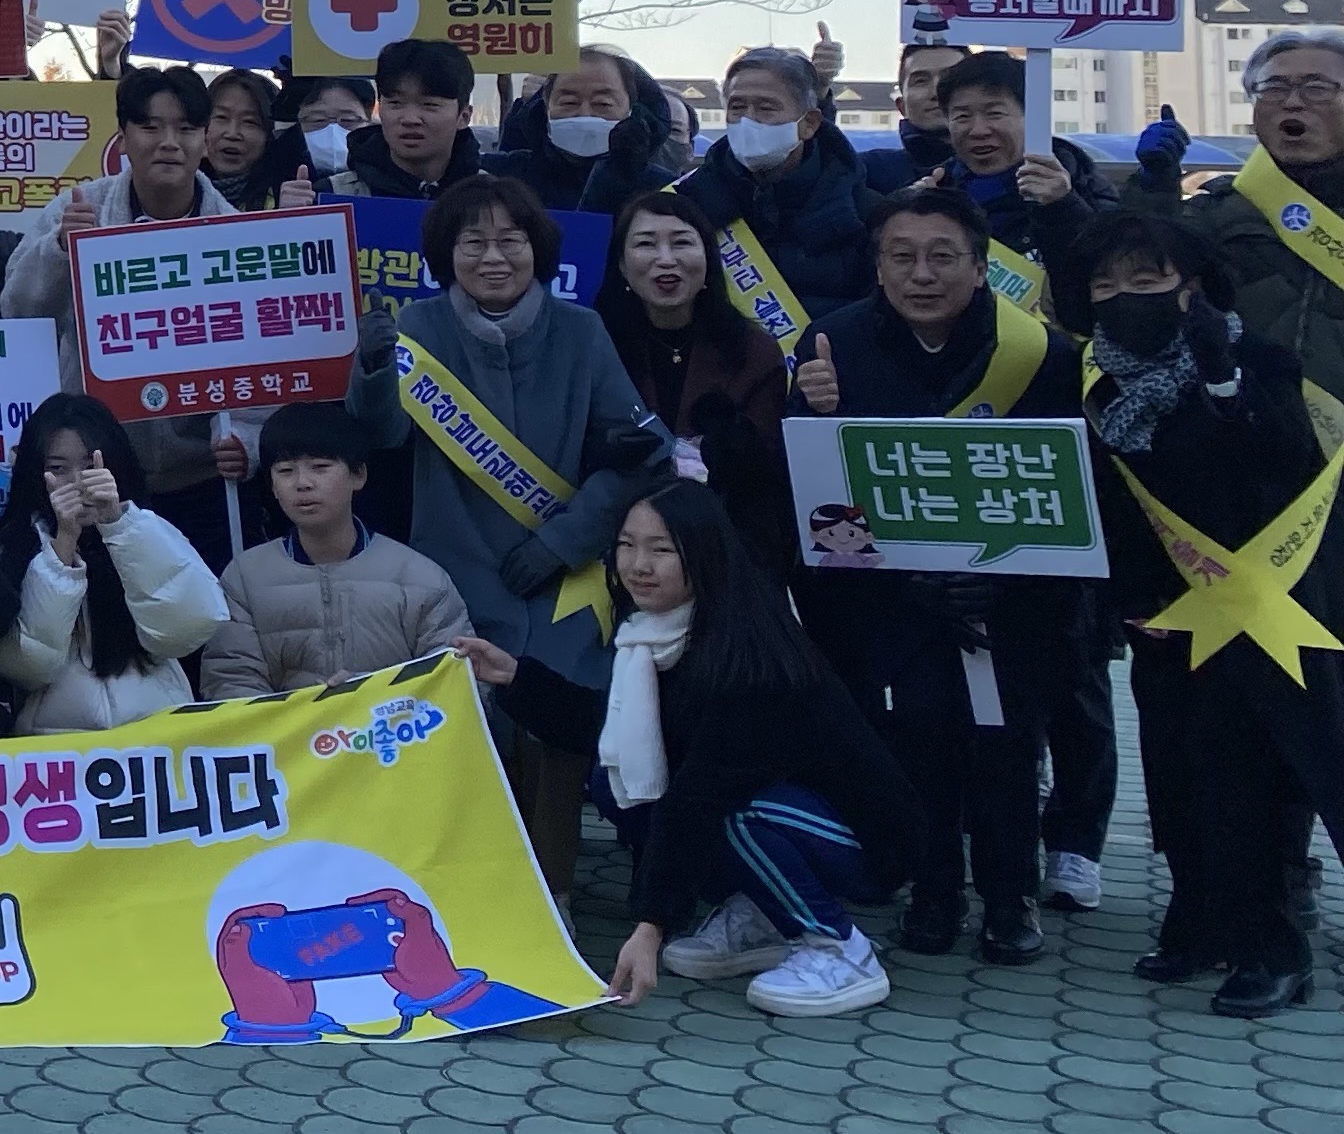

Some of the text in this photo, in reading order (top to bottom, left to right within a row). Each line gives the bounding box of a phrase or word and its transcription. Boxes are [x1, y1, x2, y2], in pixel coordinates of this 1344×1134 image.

[446, 21, 554, 56] 영원히
[94, 239, 337, 297] 바르고 고운말에
[97, 301, 244, 355] 친구얼굴
[257, 291, 345, 337] 활짝!
[752, 294, 798, 341] 실천
[177, 373, 313, 406] 분성중학교
[866, 441, 1057, 481] 너는 장난
[873, 485, 1064, 527] 나는 상처
